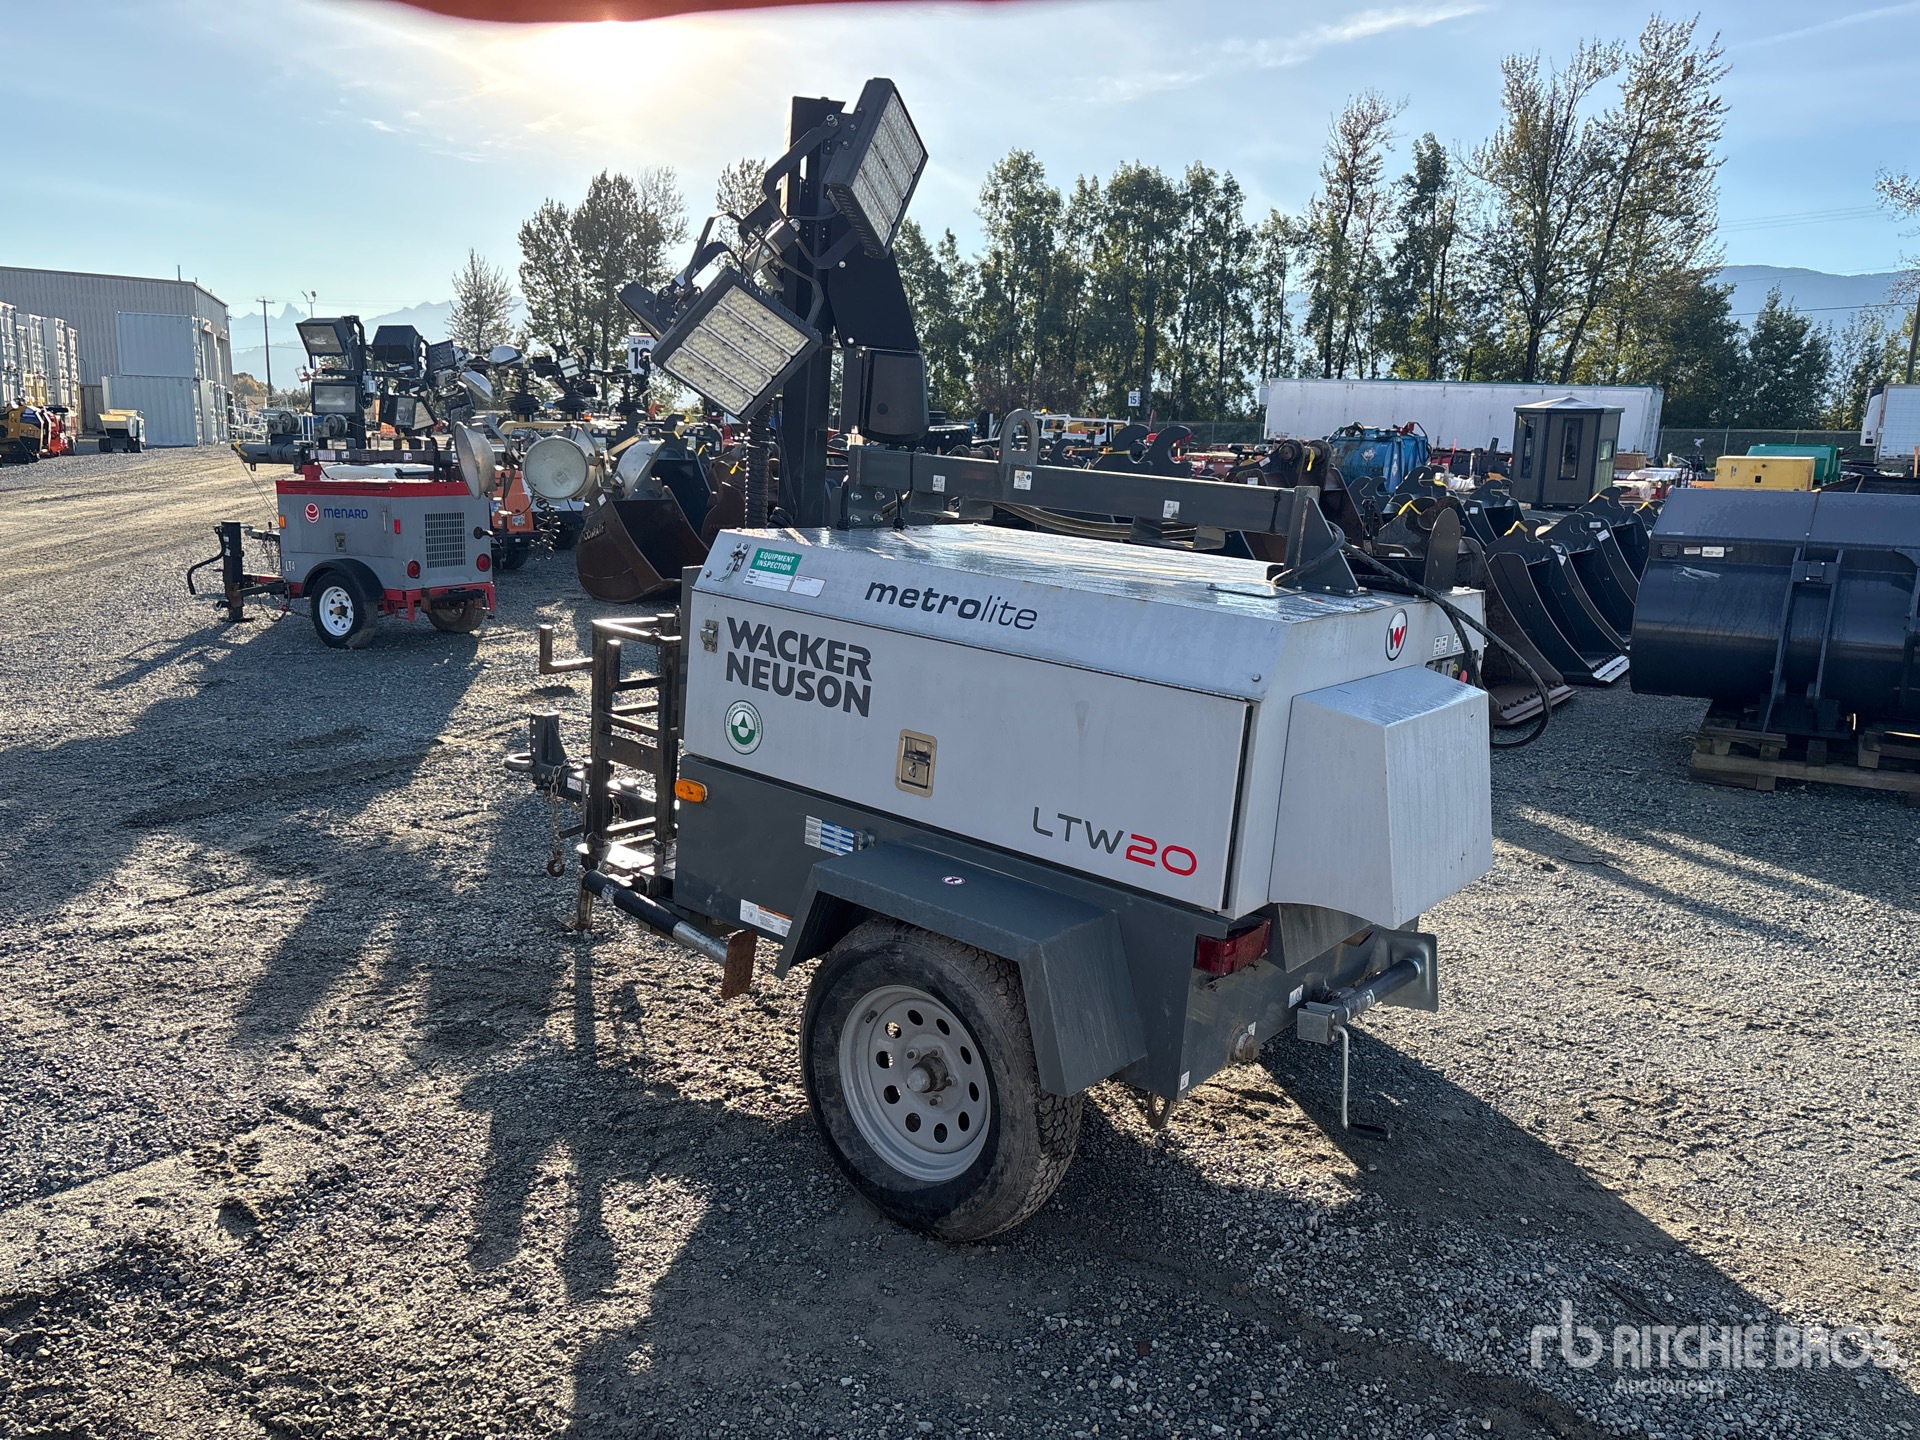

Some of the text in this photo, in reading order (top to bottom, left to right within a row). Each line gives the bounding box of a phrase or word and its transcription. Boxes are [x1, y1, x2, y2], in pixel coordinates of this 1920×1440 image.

[756, 559, 792, 571] INSPECTION
[760, 551, 795, 563] EQUIPMENT
[864, 581, 1038, 630] metrolite
[727, 616, 873, 682] WACKER
[725, 651, 872, 718] NEUSON
[1032, 806, 1198, 876] LTW20
